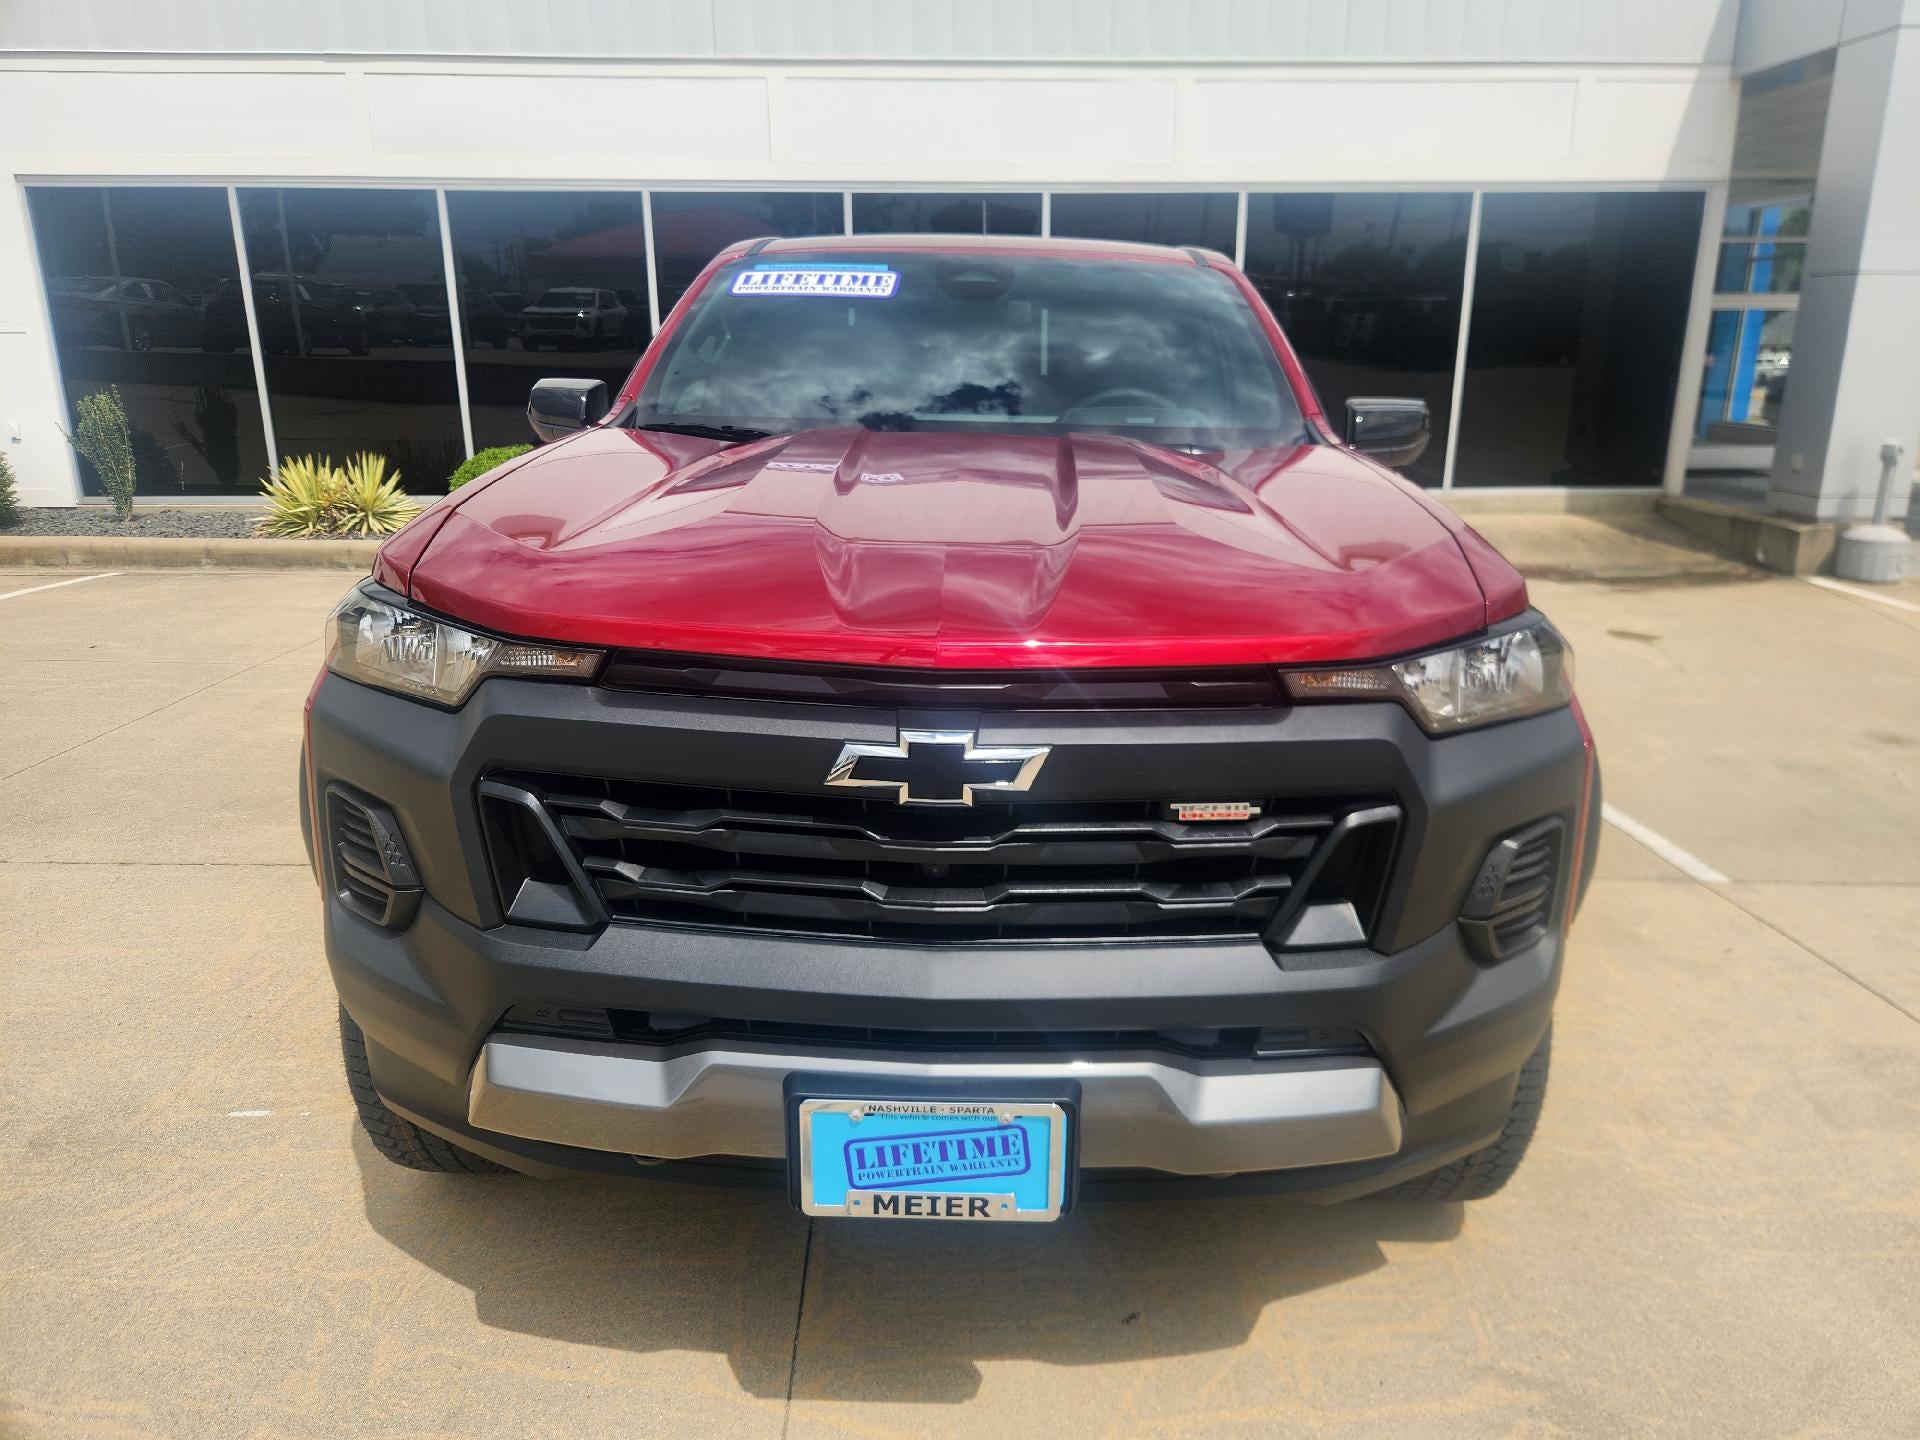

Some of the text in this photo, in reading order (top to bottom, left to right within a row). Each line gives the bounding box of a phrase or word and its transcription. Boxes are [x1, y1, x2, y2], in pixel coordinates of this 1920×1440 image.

[742, 273, 892, 287] LIFETIME
[821, 286, 888, 294] WARRANTY
[868, 1104, 995, 1115] NASHVILLE SPARTA
[899, 1113, 930, 1121] vehicle
[931, 1114, 959, 1122] comes
[960, 1114, 980, 1122] with
[854, 1134, 1022, 1170] LIFETIME
[857, 1157, 1022, 1181] POWERTRAIN WARRANTY
[873, 1194, 992, 1218] MEIER
